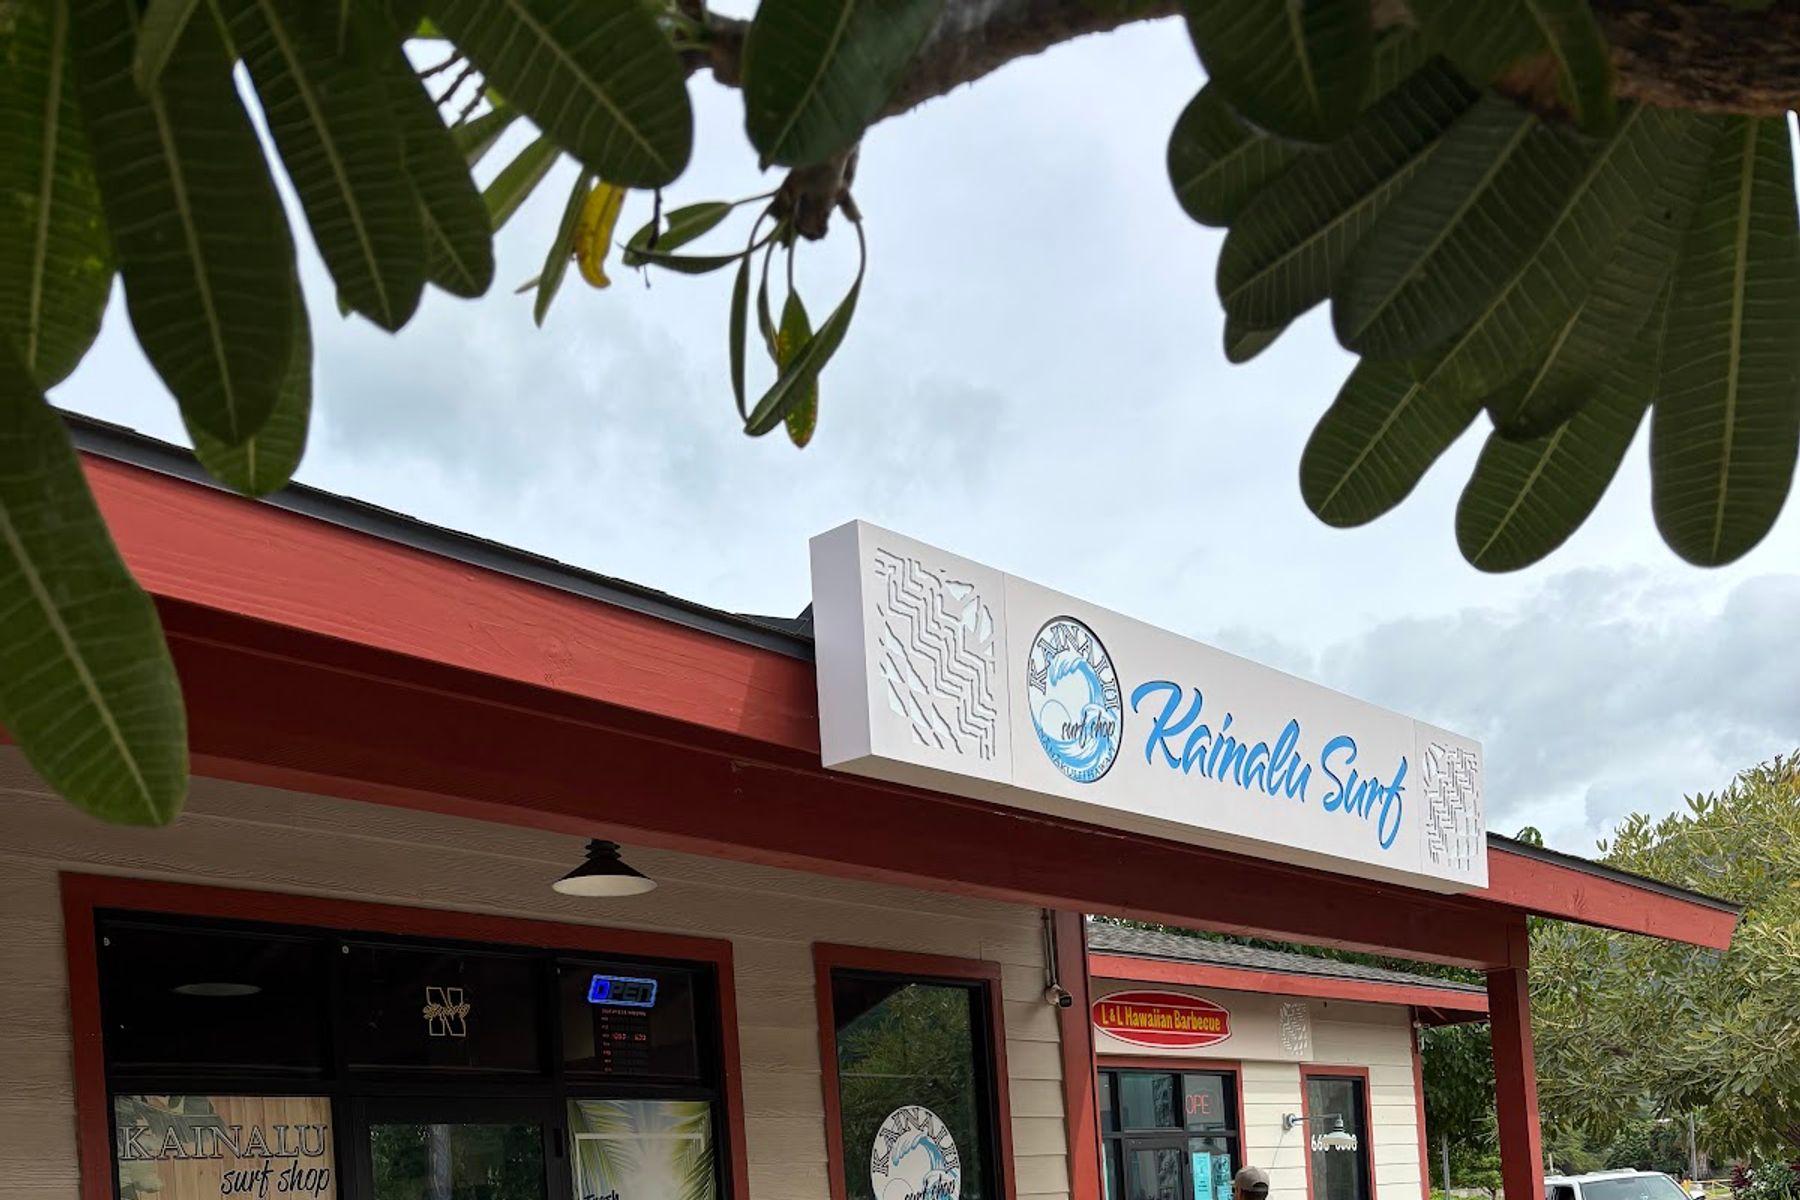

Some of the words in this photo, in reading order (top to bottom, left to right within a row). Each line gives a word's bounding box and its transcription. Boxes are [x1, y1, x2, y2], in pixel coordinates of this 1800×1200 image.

[1029, 623, 1119, 712] KAINALU
[1062, 711, 1090, 748] surf
[1131, 681, 1312, 802] Kainalu
[1321, 736, 1408, 849] Surf
[1101, 1004, 1109, 1024] L
[1125, 1006, 1173, 1029] Hawaiian
[1173, 1010, 1221, 1032] Barbecue
[118, 1124, 328, 1161] KAINALU
[872, 1107, 959, 1177] KAINALU
[221, 1160, 272, 1198] surf
[277, 1161, 330, 1198] shop
